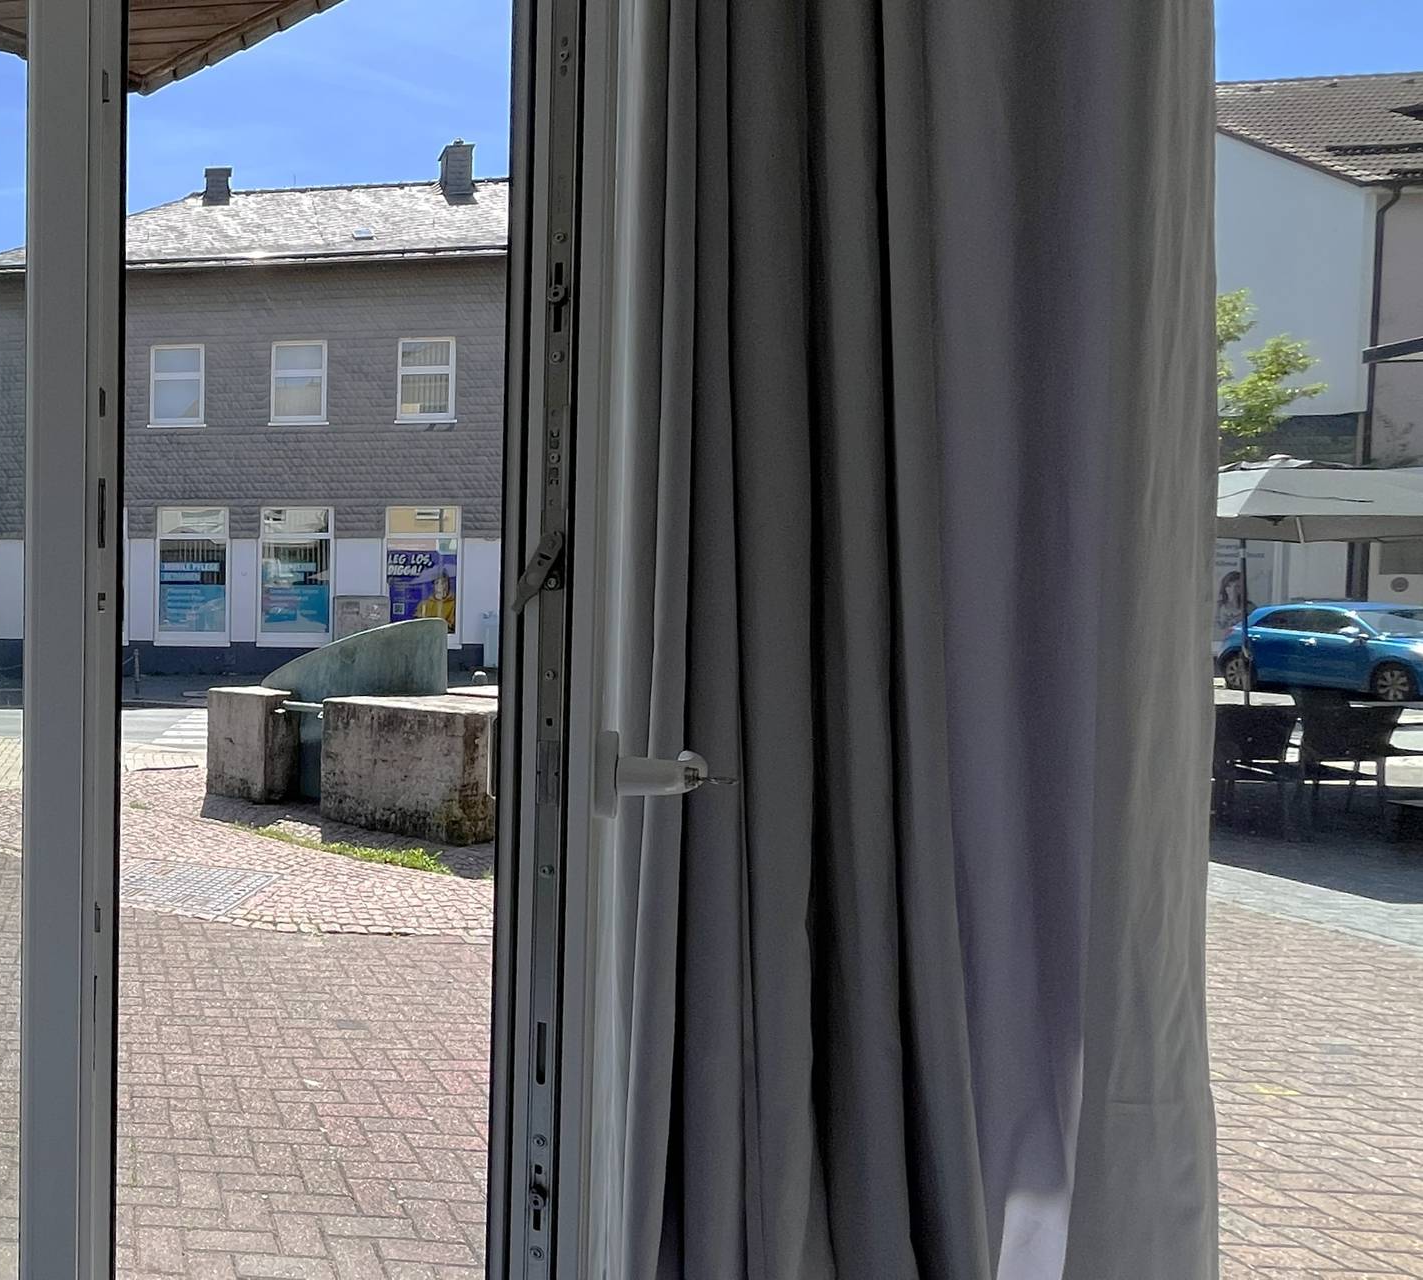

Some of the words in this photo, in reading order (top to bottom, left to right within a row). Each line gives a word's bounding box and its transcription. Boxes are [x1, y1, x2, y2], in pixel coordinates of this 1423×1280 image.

[388, 554, 407, 564] LEG
[411, 554, 432, 566] LOS,
[387, 565, 423, 575] DIGGA!
